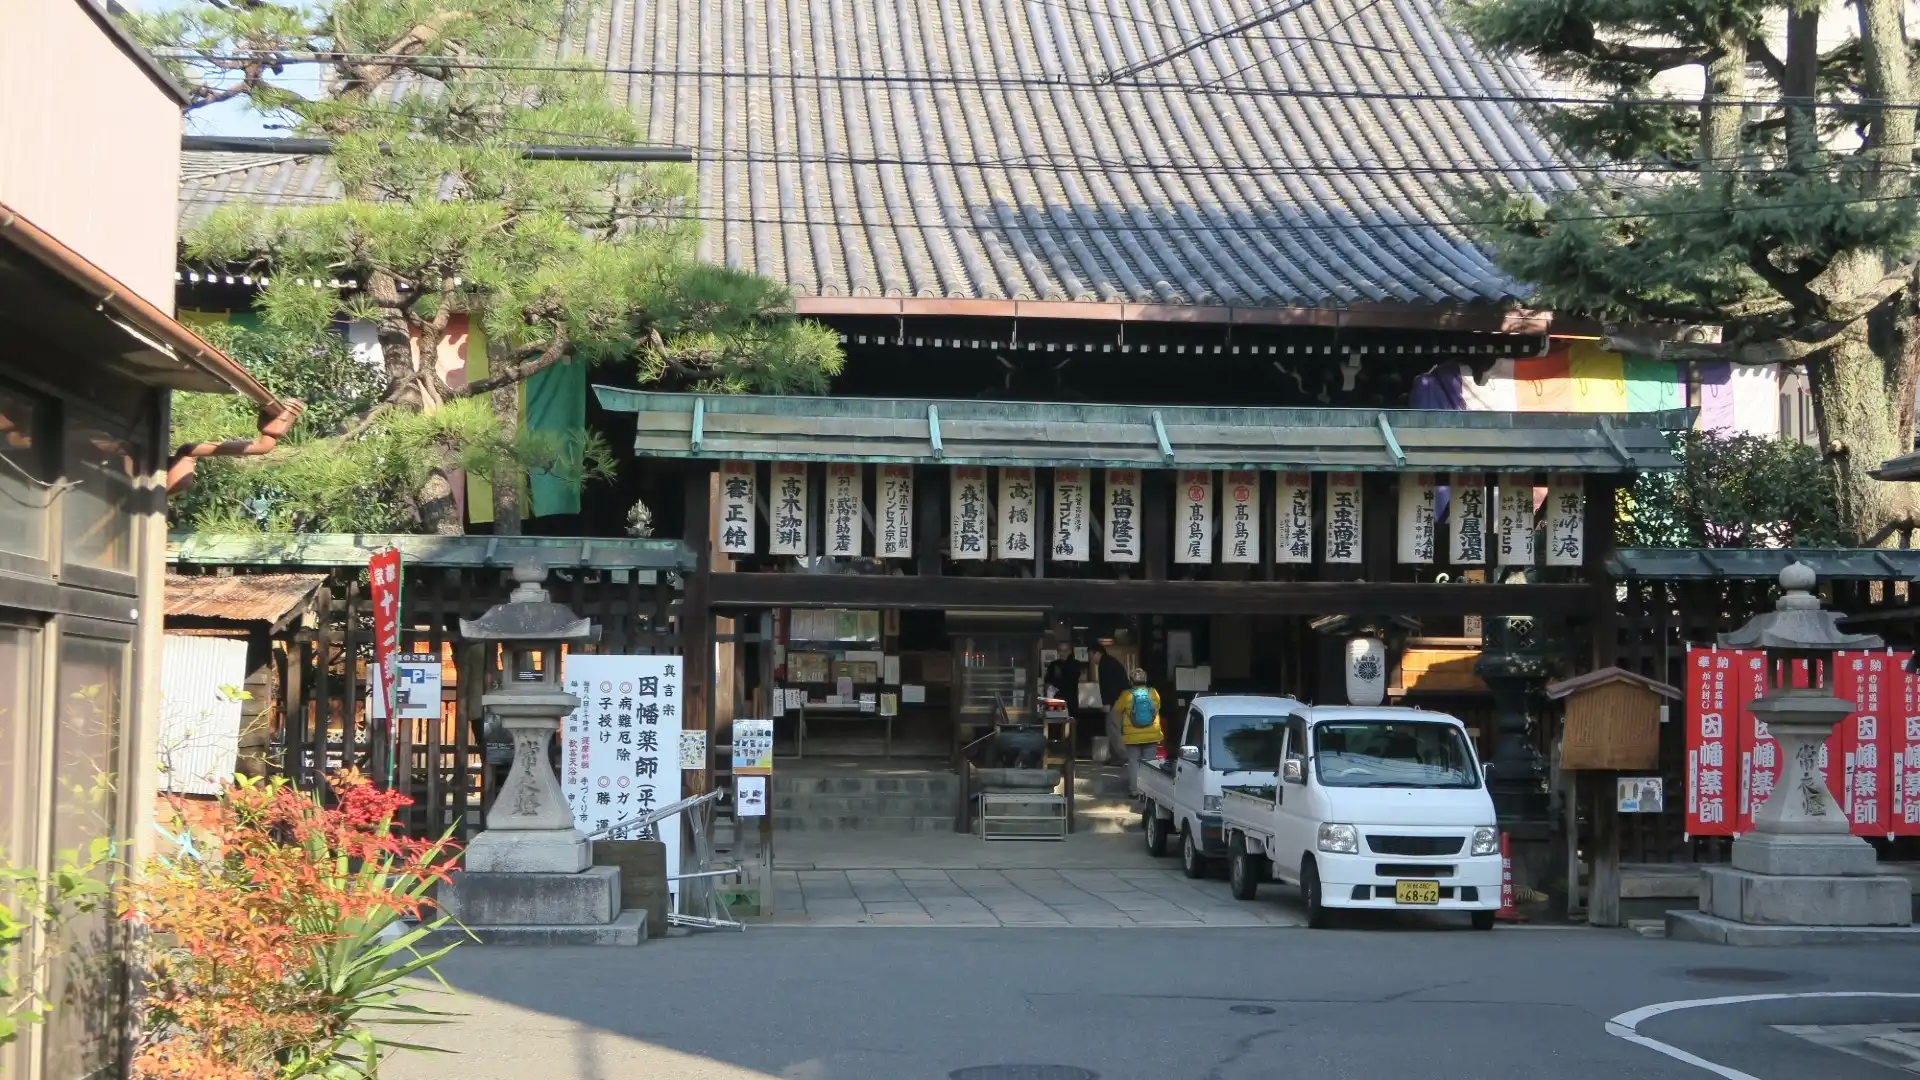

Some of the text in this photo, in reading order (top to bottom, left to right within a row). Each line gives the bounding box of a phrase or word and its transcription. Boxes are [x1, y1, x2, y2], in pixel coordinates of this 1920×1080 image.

[723, 477, 748, 548] 審正館
[885, 481, 896, 553] プリンセス京都
[899, 495, 908, 548] ホテル日航
[960, 484, 981, 552] 森島医院
[1331, 491, 1355, 558] 玉虫商店
[1421, 489, 1434, 560] 中一有限会社
[1457, 489, 1482, 560] 伏見屋酒店
[1502, 516, 1512, 554] カゴヒロ
[1556, 493, 1580, 558] 薬師庵
[1698, 656, 1728, 668] 奉納
[1852, 659, 1882, 671] 奉納
[663, 664, 676, 716] 真言宗
[1701, 672, 1711, 709] がん封じ
[1857, 674, 1865, 711] がん封じ
[598, 697, 613, 743] 子授け
[616, 697, 632, 762] 病難厄除
[1700, 713, 1723, 823] 因幡薬師
[1855, 715, 1877, 824] 因幡薬師
[579, 776, 589, 822] 手づくり市
[1405, 890, 1436, 901] 68-62
[1502, 858, 1512, 907] 駐車禁止
